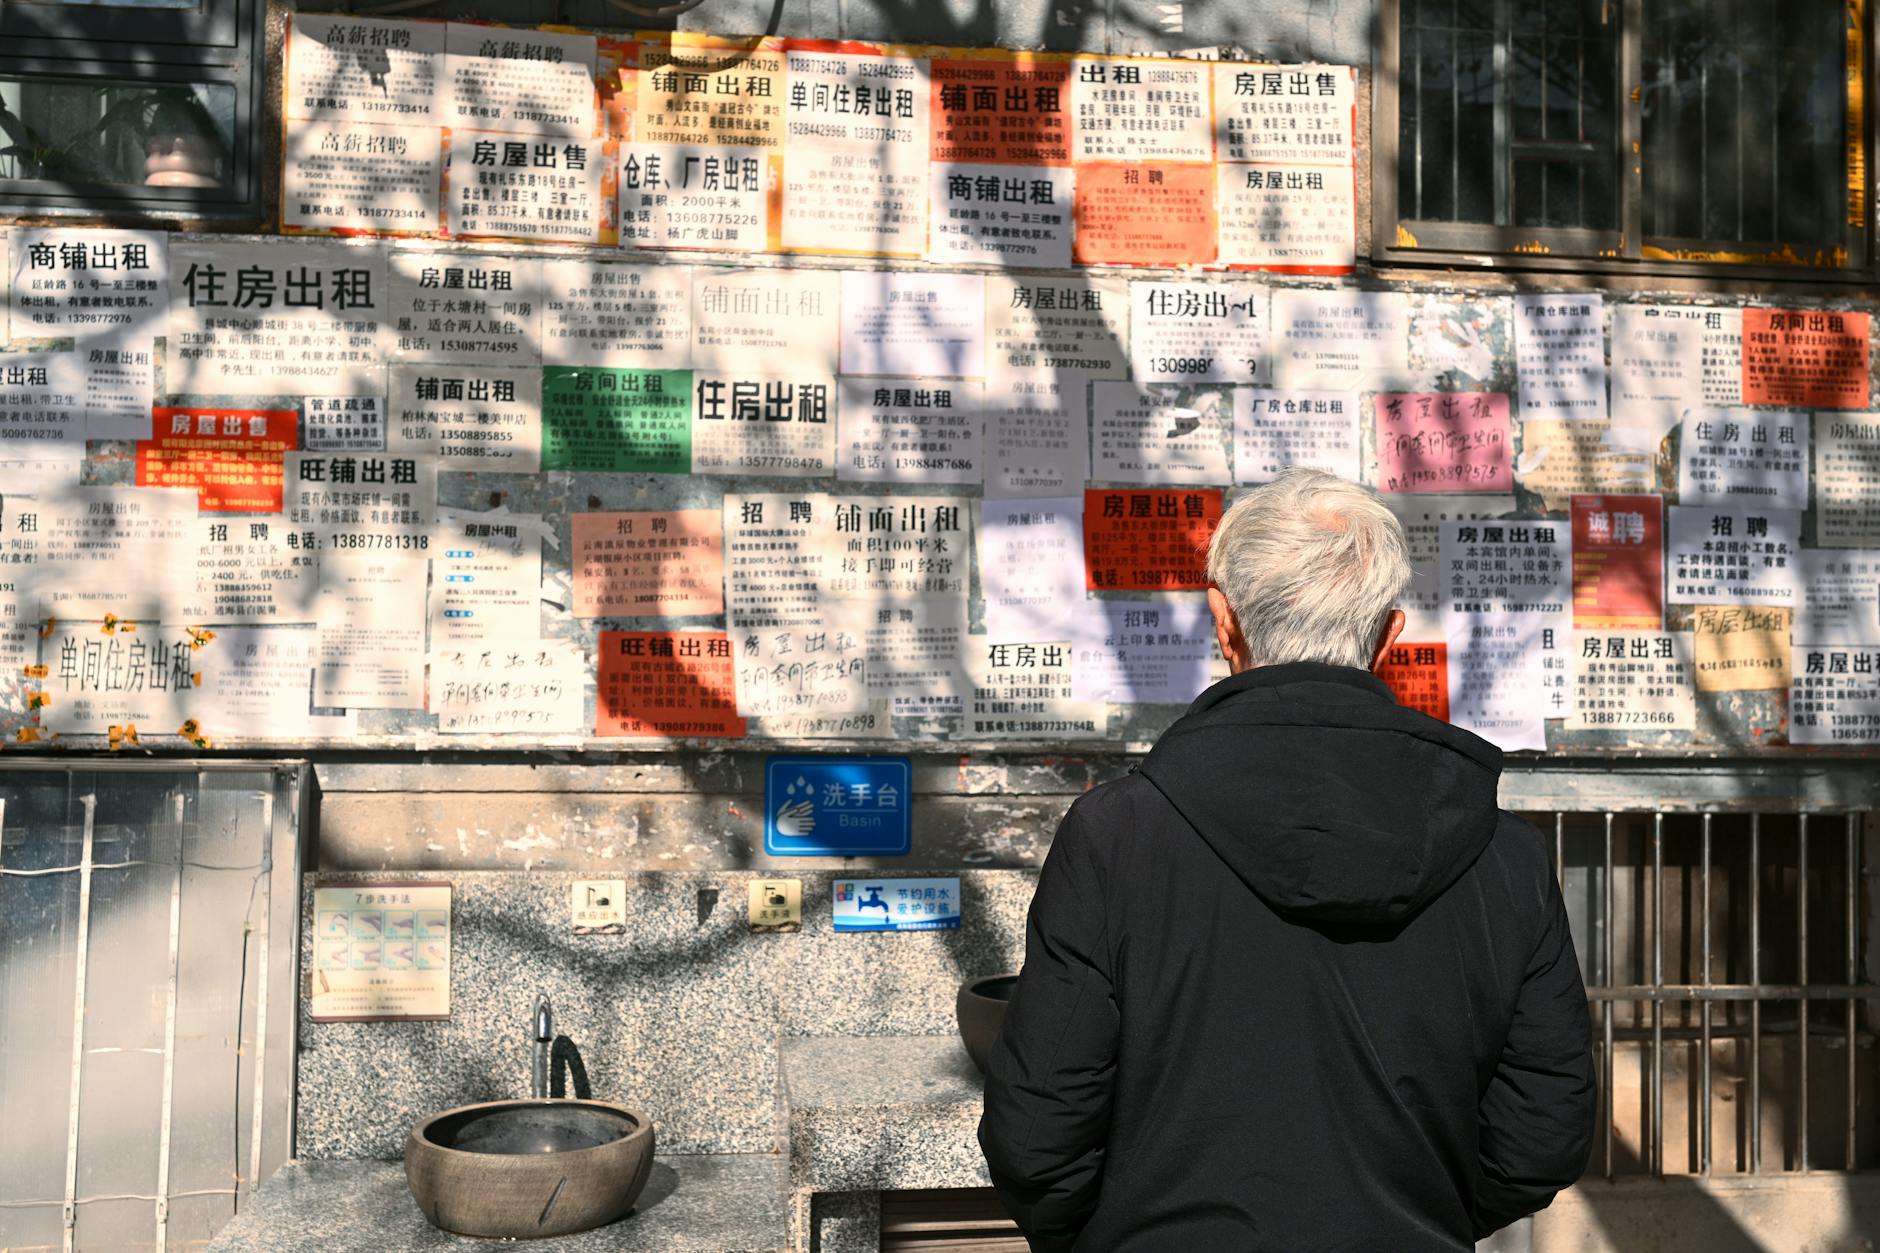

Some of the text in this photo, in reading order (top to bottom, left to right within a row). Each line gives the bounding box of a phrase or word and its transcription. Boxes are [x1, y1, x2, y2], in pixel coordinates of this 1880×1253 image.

[326, 24, 412, 47] 高薪招聘
[479, 39, 564, 64] 高薪招聘
[789, 57, 915, 80] 13887764726 15284429966
[1080, 64, 1142, 84] 出租
[651, 71, 773, 97] 铺面出租
[1233, 72, 1337, 97] 房屋出售
[789, 80, 914, 119] 单间住房出租
[939, 84, 1062, 112] 铺面出租
[320, 131, 408, 155] 高薪招聘
[647, 131, 778, 147] 13887764726 15284429966
[471, 140, 588, 171] 房屋出售
[623, 153, 760, 193] 仓库、厂房出租
[1123, 169, 1164, 185] 招聘
[1246, 170, 1323, 190] 房屋出租
[947, 174, 1055, 205] 商铺出租
[28, 242, 150, 270] 商铺出租
[182, 262, 375, 310] 住房出租
[418, 267, 513, 291] 房屋出租
[412, 298, 532, 317] 位于水塘村一间房
[700, 284, 824, 318] 铺面出租
[1010, 285, 1103, 311] 房屋出租
[1525, 305, 1591, 317] 厂房仓库出租
[1769, 313, 1844, 333] 房间出租
[88, 349, 149, 365] 房屋出租
[0, 366, 48, 386] 出租
[575, 372, 663, 392] 房间出租
[415, 377, 516, 402] 铺面出租
[872, 387, 952, 409] 房屋出租
[311, 398, 375, 411] 管道疏通
[697, 379, 827, 423] 住房出租
[1252, 399, 1344, 414] 厂房仓库出租
[171, 414, 268, 437] 房屋出售
[1695, 421, 1797, 445] 住房出租
[1830, 423, 1880, 444] 房屋出
[300, 458, 417, 484] 旺铺出租
[741, 501, 813, 524] 招聘
[1102, 494, 1205, 519] 房屋出售
[616, 518, 668, 535] 招聘
[835, 504, 961, 533] 铺面出租
[1007, 512, 1056, 526] 房屋出租
[1711, 515, 1769, 538] 招聘
[208, 523, 269, 542] 招聘
[1457, 526, 1556, 543] 房屋出租
[847, 537, 949, 553] 面积100平米
[841, 557, 953, 574] 接手即可经营
[1092, 569, 1218, 587] 电话：1398776306
[877, 608, 914, 624] 招聘
[1124, 610, 1160, 628] 招聘
[620, 637, 730, 657] 旺铺出租
[1104, 634, 1183, 647] 云上印象酒店
[1582, 637, 1675, 659] 房屋出租
[57, 636, 193, 693] 单间住房出租
[988, 644, 1071, 668] 住房出
[1806, 652, 1880, 674] 房屋出
[822, 782, 900, 808] 洗手台
[839, 813, 882, 828] Basin
